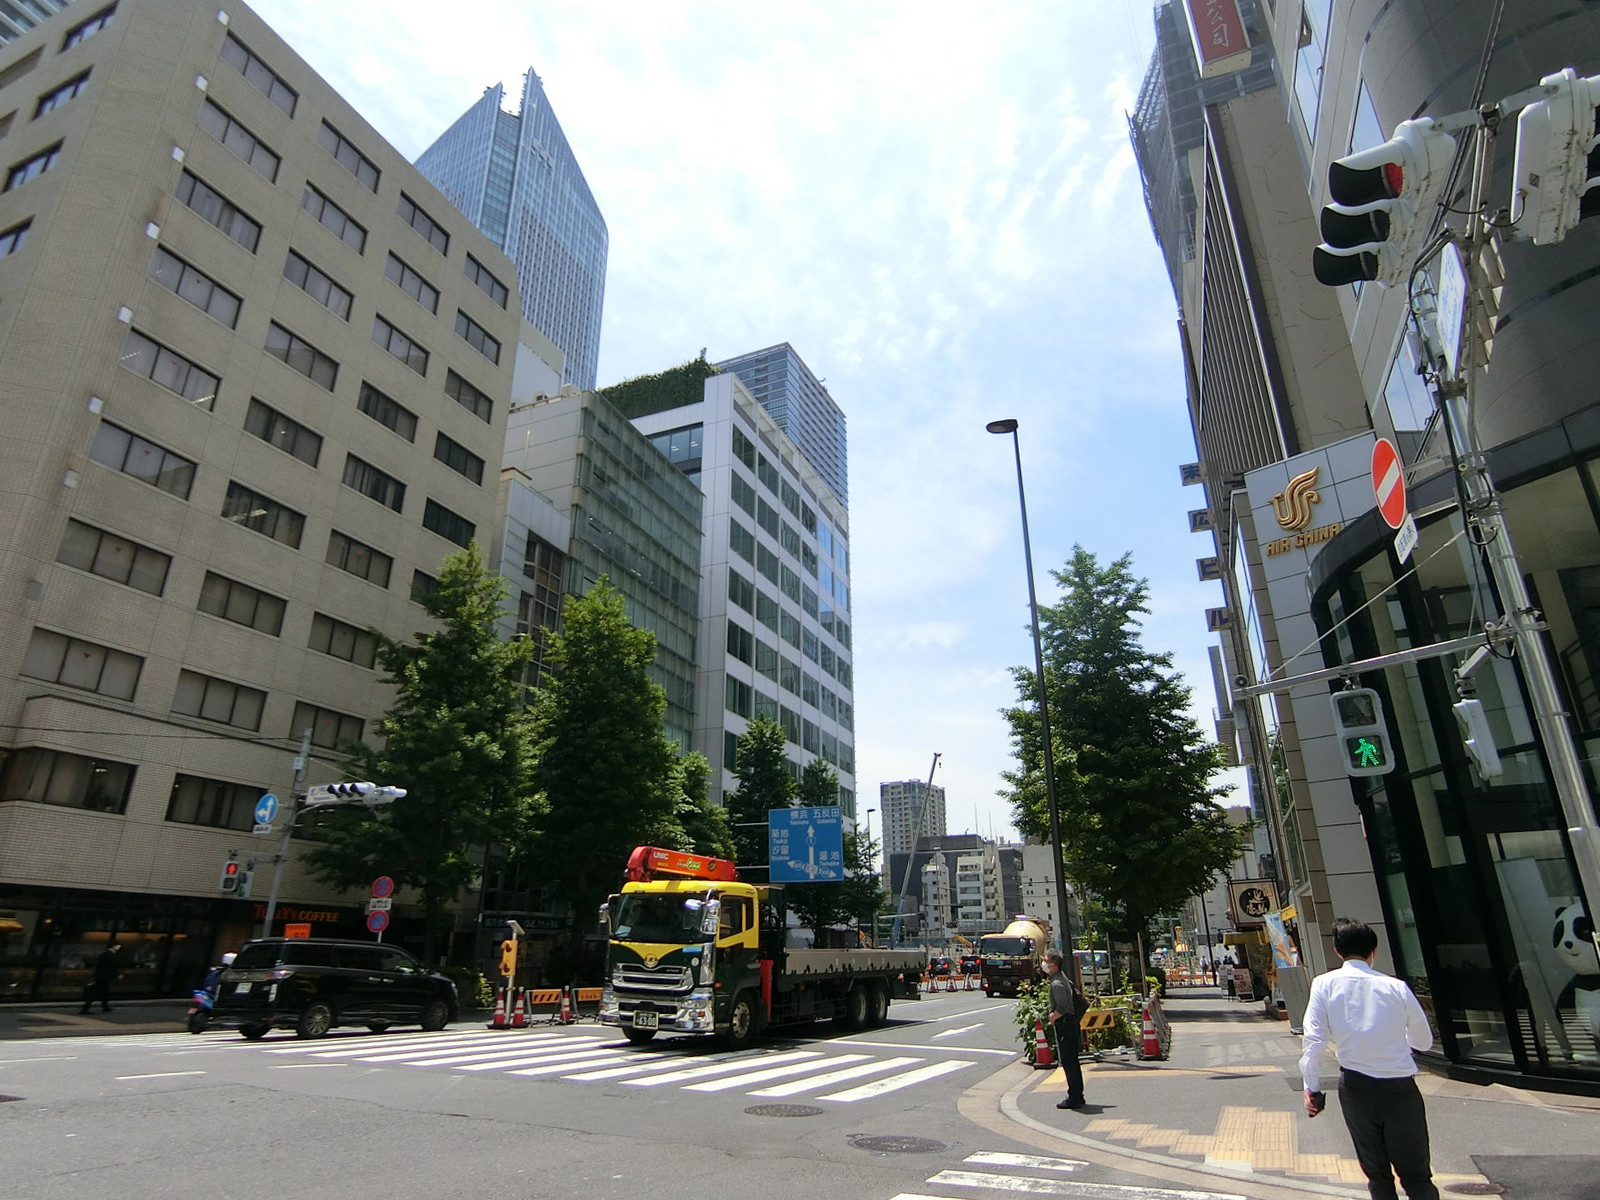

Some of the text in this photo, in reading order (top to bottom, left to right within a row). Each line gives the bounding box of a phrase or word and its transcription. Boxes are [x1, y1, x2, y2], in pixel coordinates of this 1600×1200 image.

[1266, 523, 1341, 557] AIR CHINA
[790, 808, 840, 819] 横浜 五反田
[771, 828, 789, 838] 築地
[771, 845, 789, 855] 汐留
[653, 851, 670, 860] UNIC
[819, 851, 840, 860] 溜池
[298, 910, 340, 922] COFFEE
